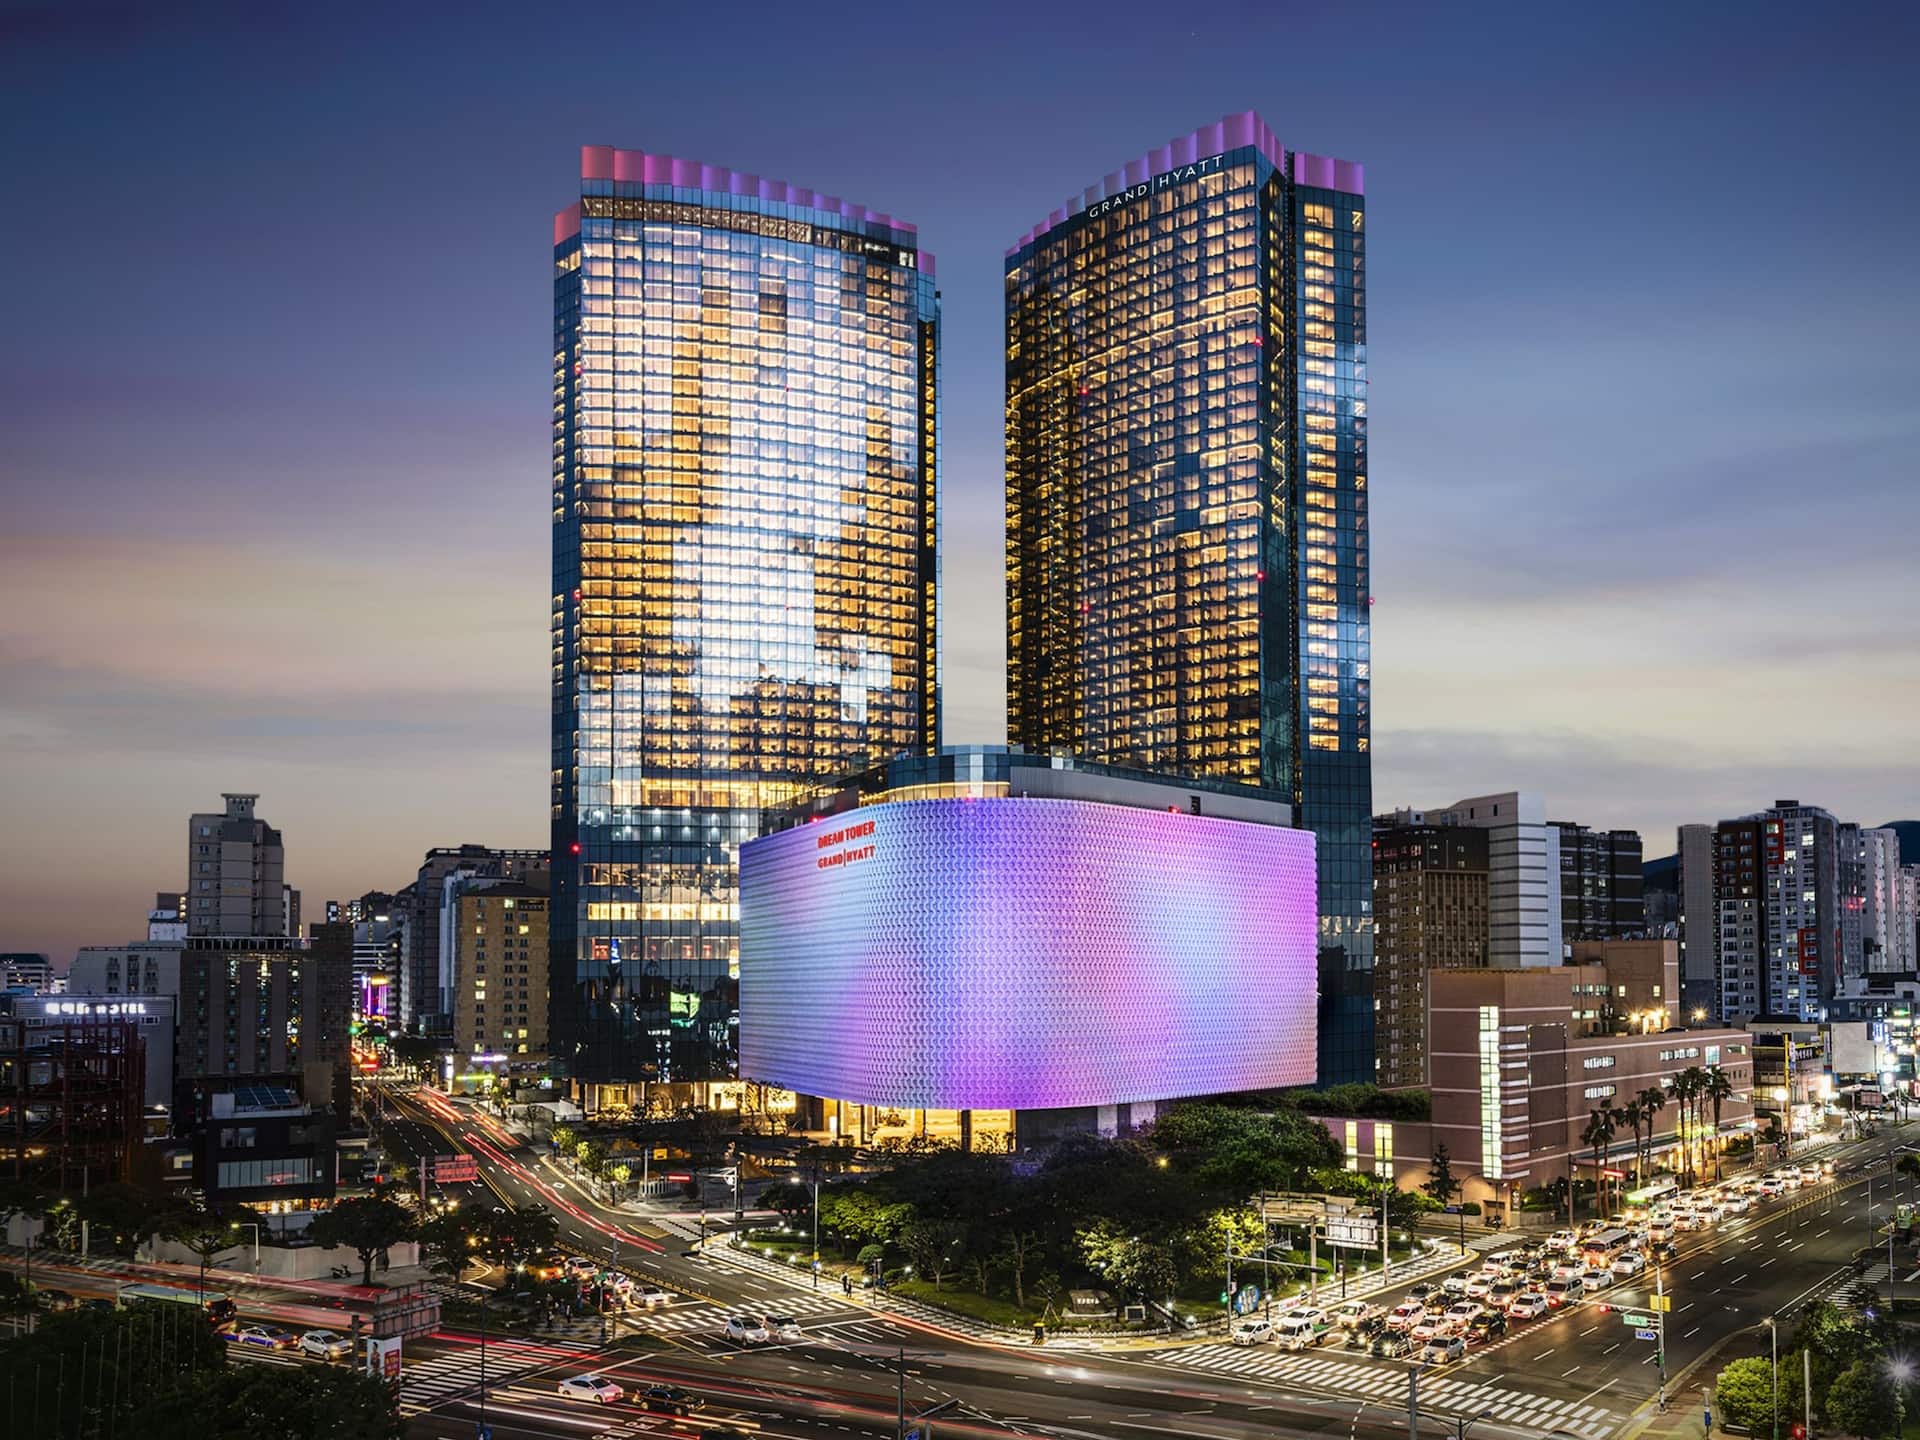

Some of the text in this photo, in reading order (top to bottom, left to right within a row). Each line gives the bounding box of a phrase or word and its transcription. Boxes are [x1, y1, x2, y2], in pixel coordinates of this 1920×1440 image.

[1089, 155, 1223, 218] GRAND HYATT
[818, 821, 876, 849] DREAM TOWER
[818, 845, 876, 869] GRAND HYATT
